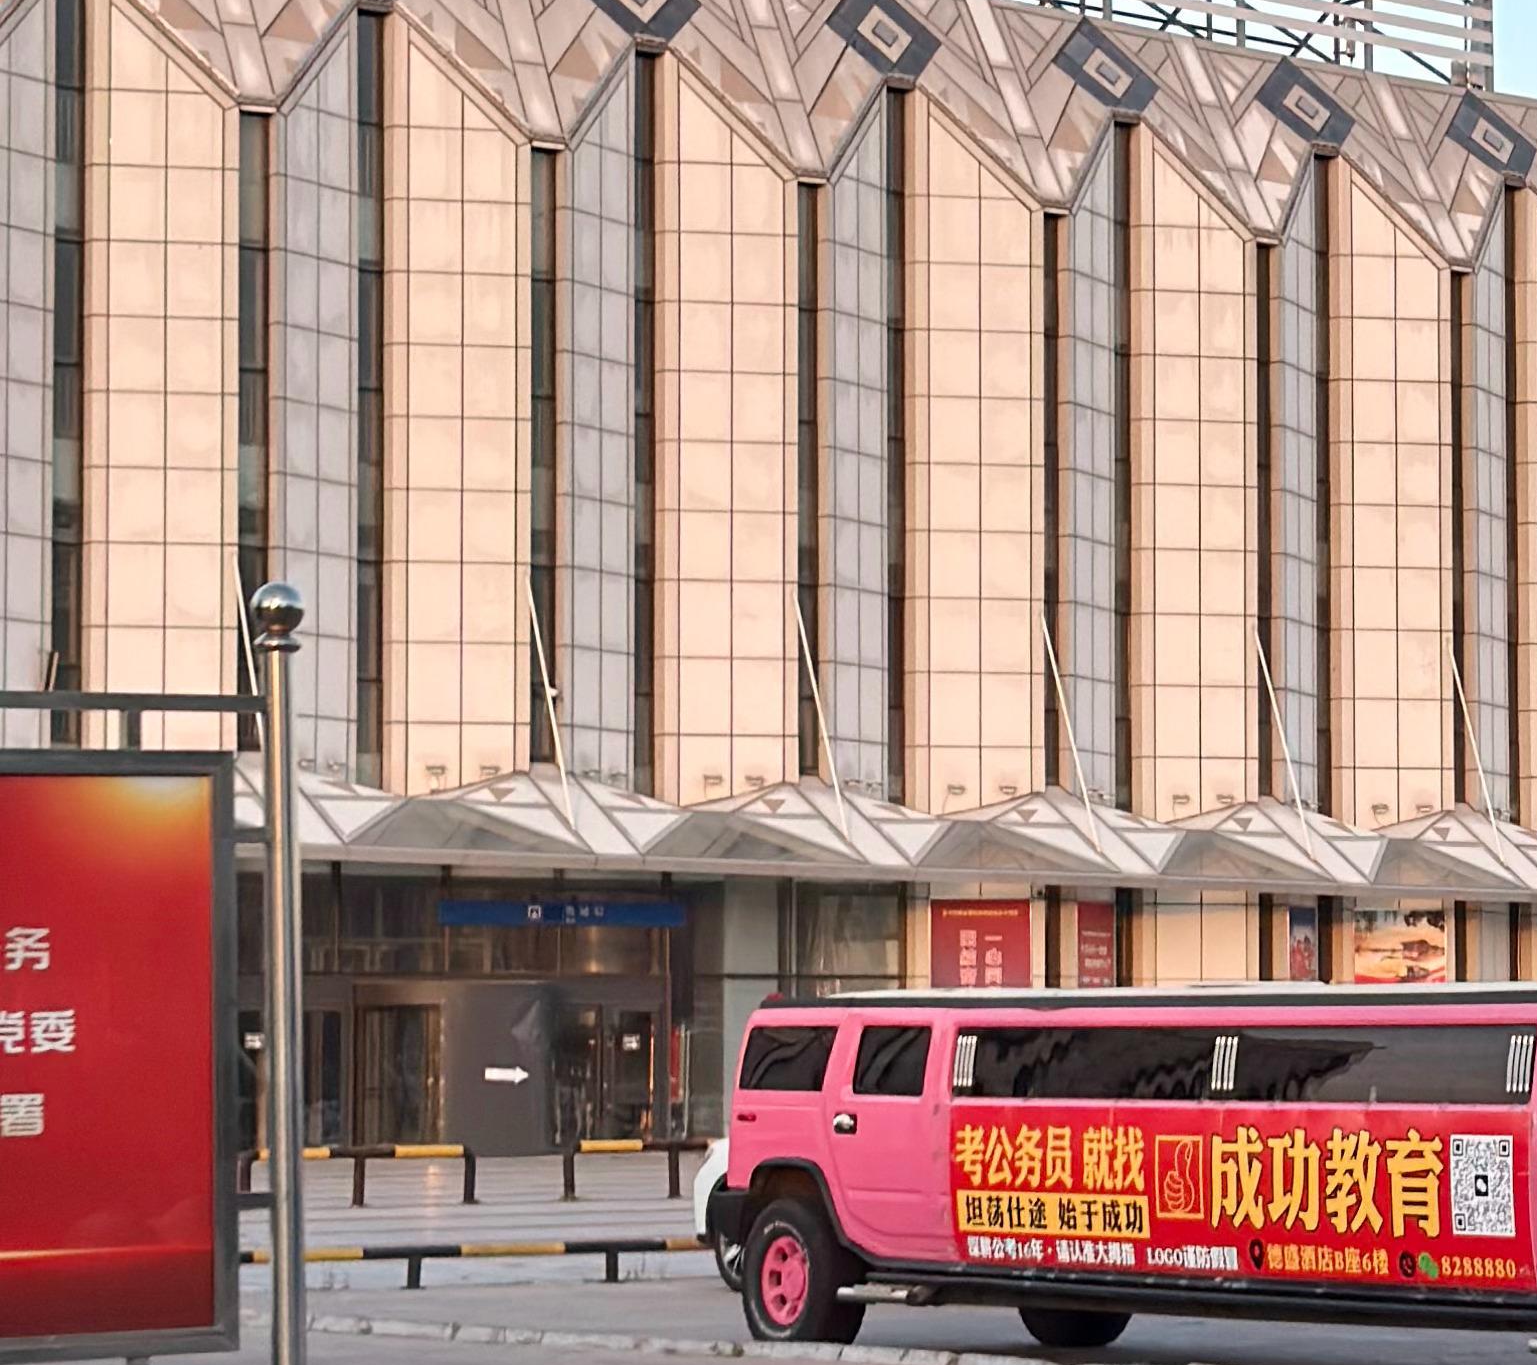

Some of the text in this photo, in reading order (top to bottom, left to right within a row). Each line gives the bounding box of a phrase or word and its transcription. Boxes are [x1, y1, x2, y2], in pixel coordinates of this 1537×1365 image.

[4, 926, 50, 971] 务
[955, 1124, 1145, 1192] 考公务员 就找
[1210, 1125, 1444, 1238] 成功教育
[965, 1194, 1144, 1233] 坦荡仕途 始于成功
[1440, 1254, 1517, 1279] 8288880
